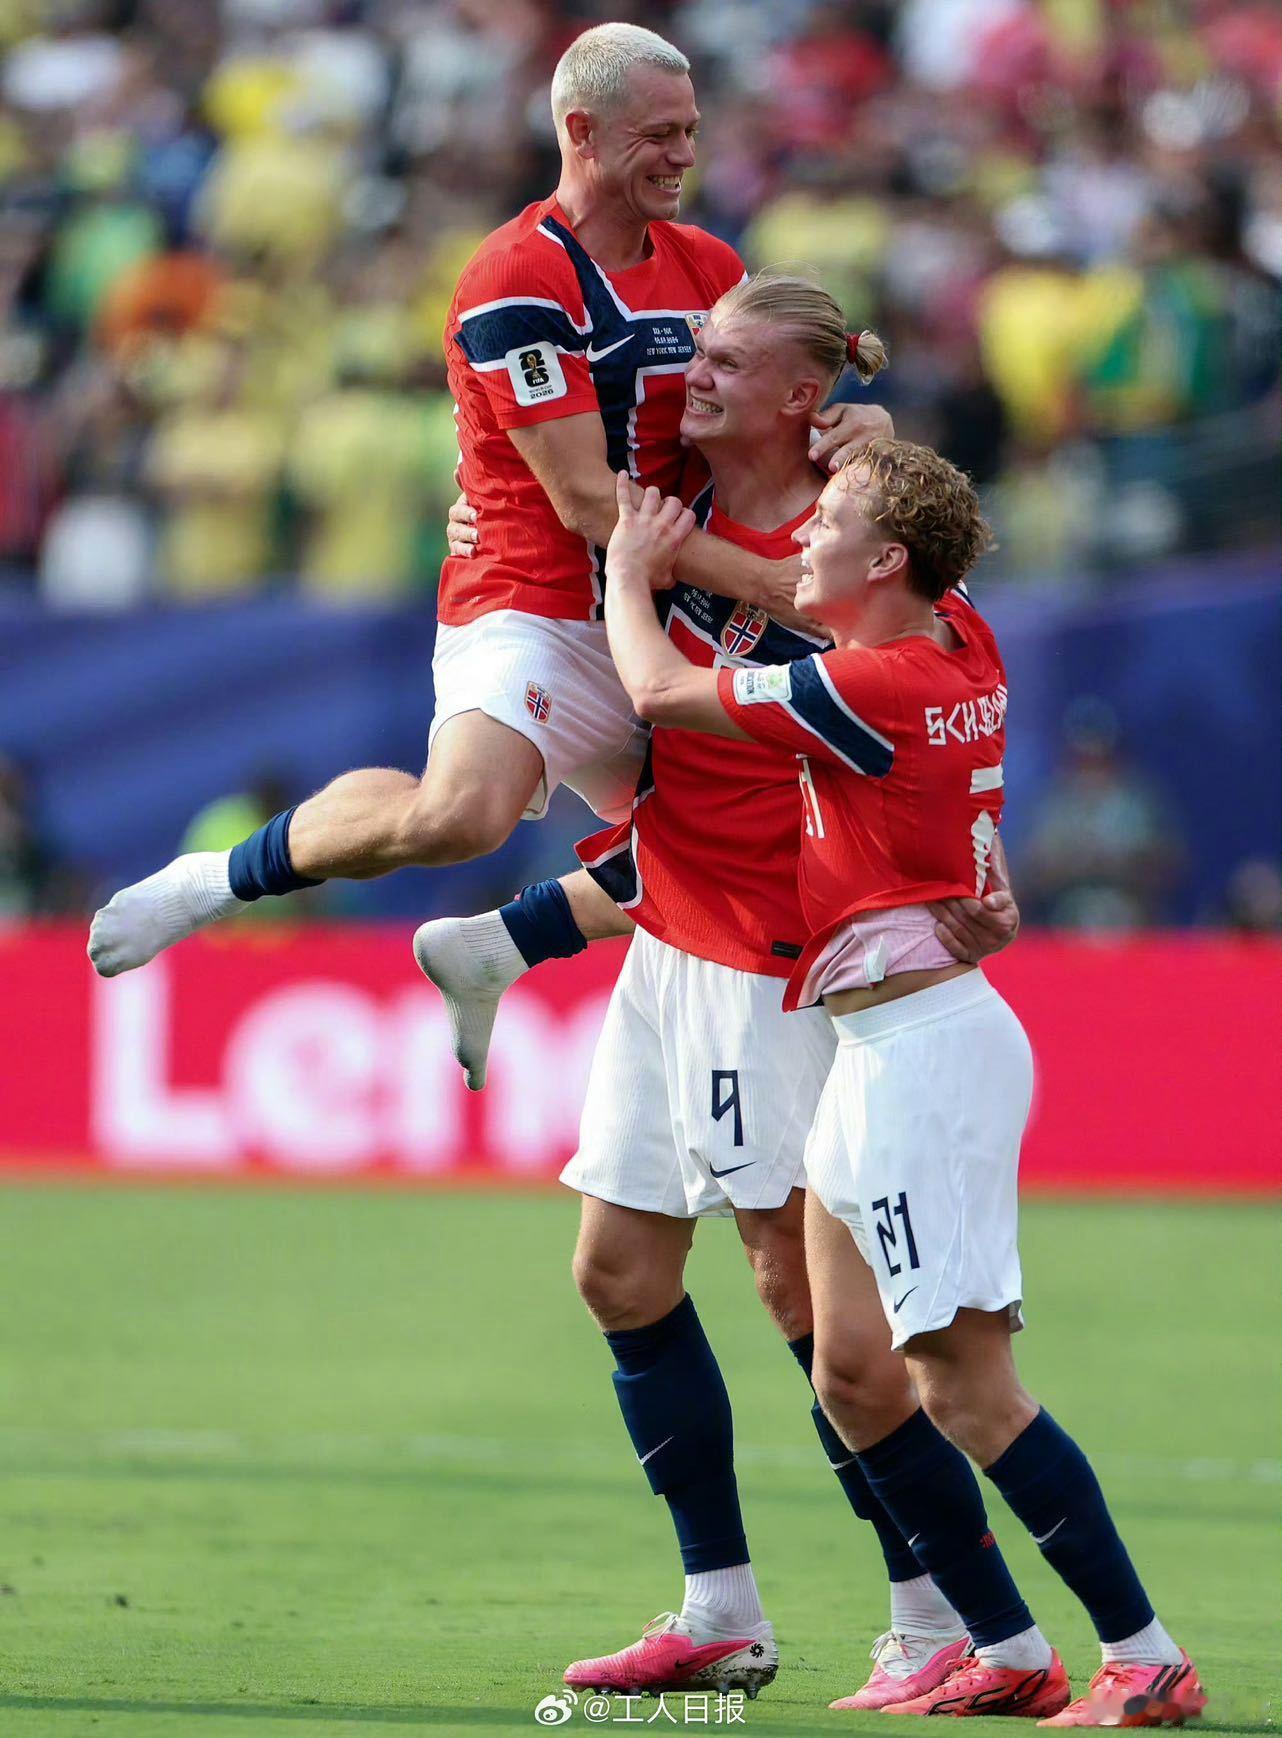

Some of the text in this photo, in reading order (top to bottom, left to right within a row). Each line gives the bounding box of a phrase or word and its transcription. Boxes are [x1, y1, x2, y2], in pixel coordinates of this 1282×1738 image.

[530, 389, 554, 399] 2026
[89, 956, 607, 1173] Len
[711, 1069, 744, 1147] 9
[871, 1191, 921, 1277] 21
